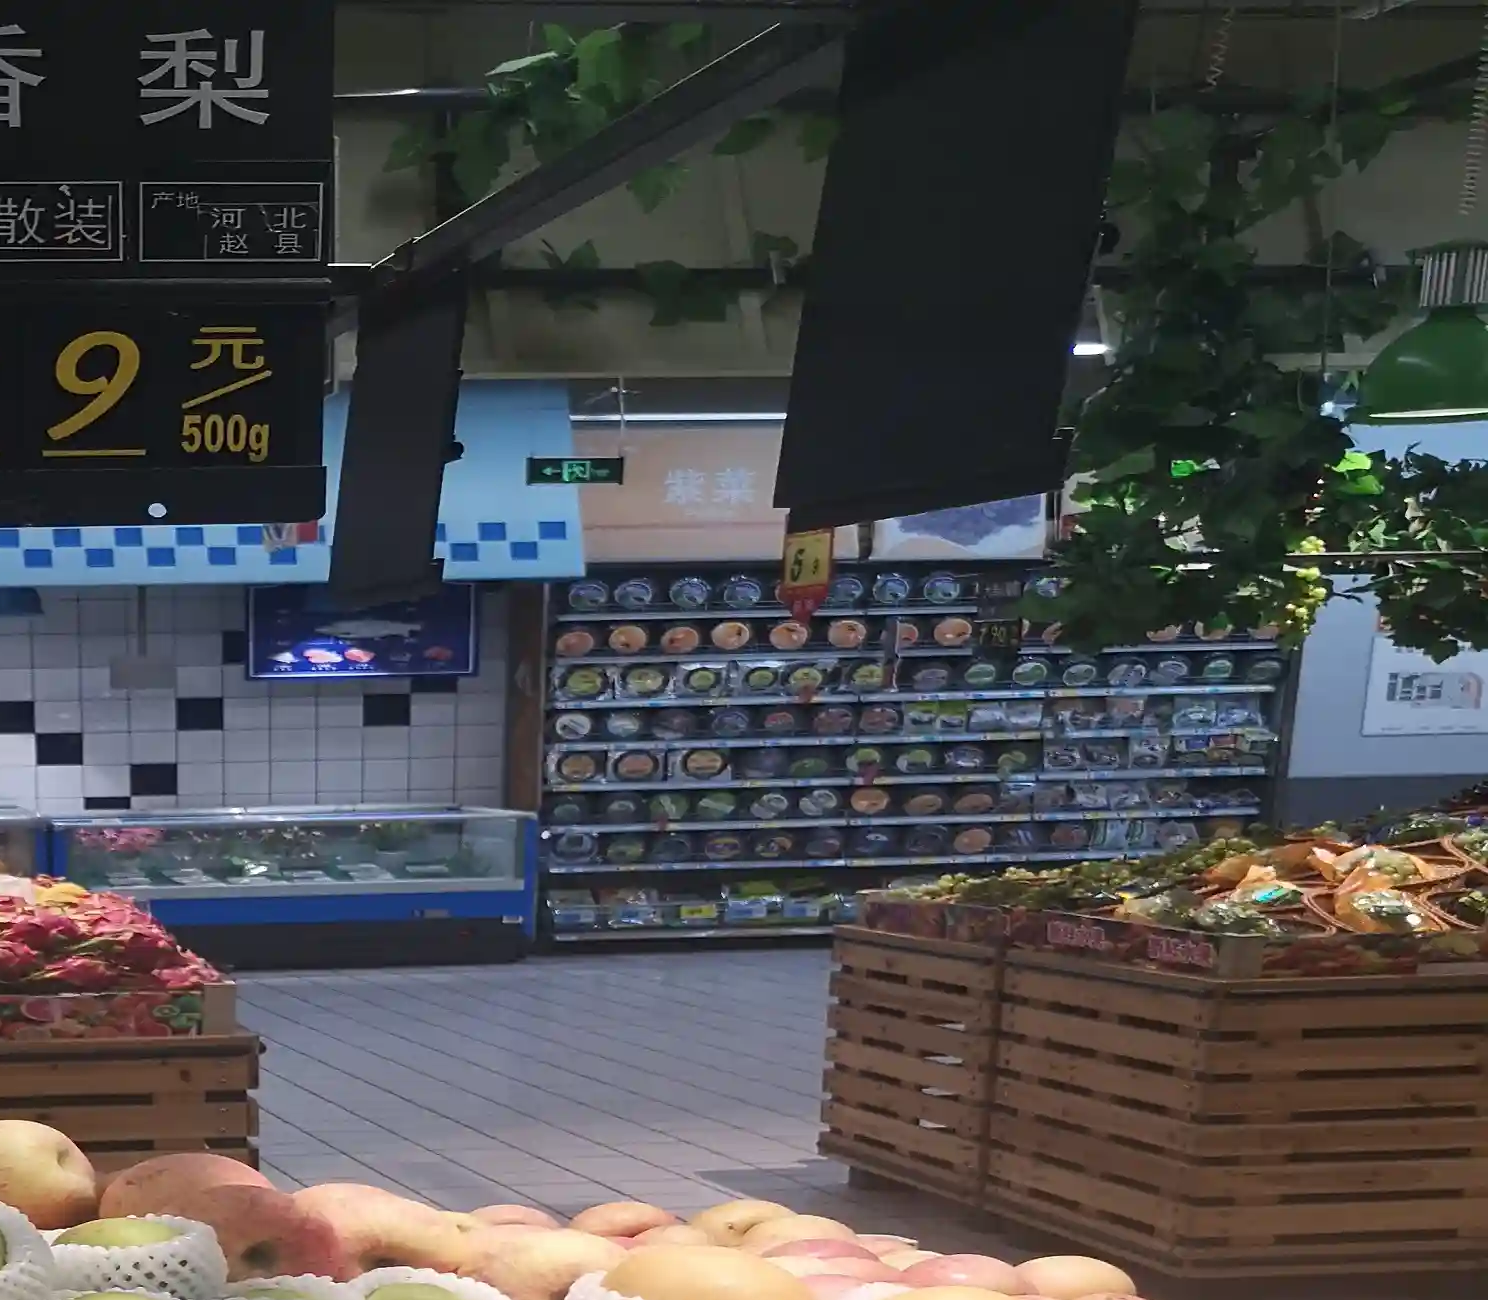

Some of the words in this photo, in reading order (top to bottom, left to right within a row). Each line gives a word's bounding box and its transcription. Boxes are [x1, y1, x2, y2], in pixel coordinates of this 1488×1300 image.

[151, 192, 199, 209] 产地
[211, 207, 306, 230] 河北
[219, 232, 303, 255] 赵县
[181, 414, 270, 463] 500g
